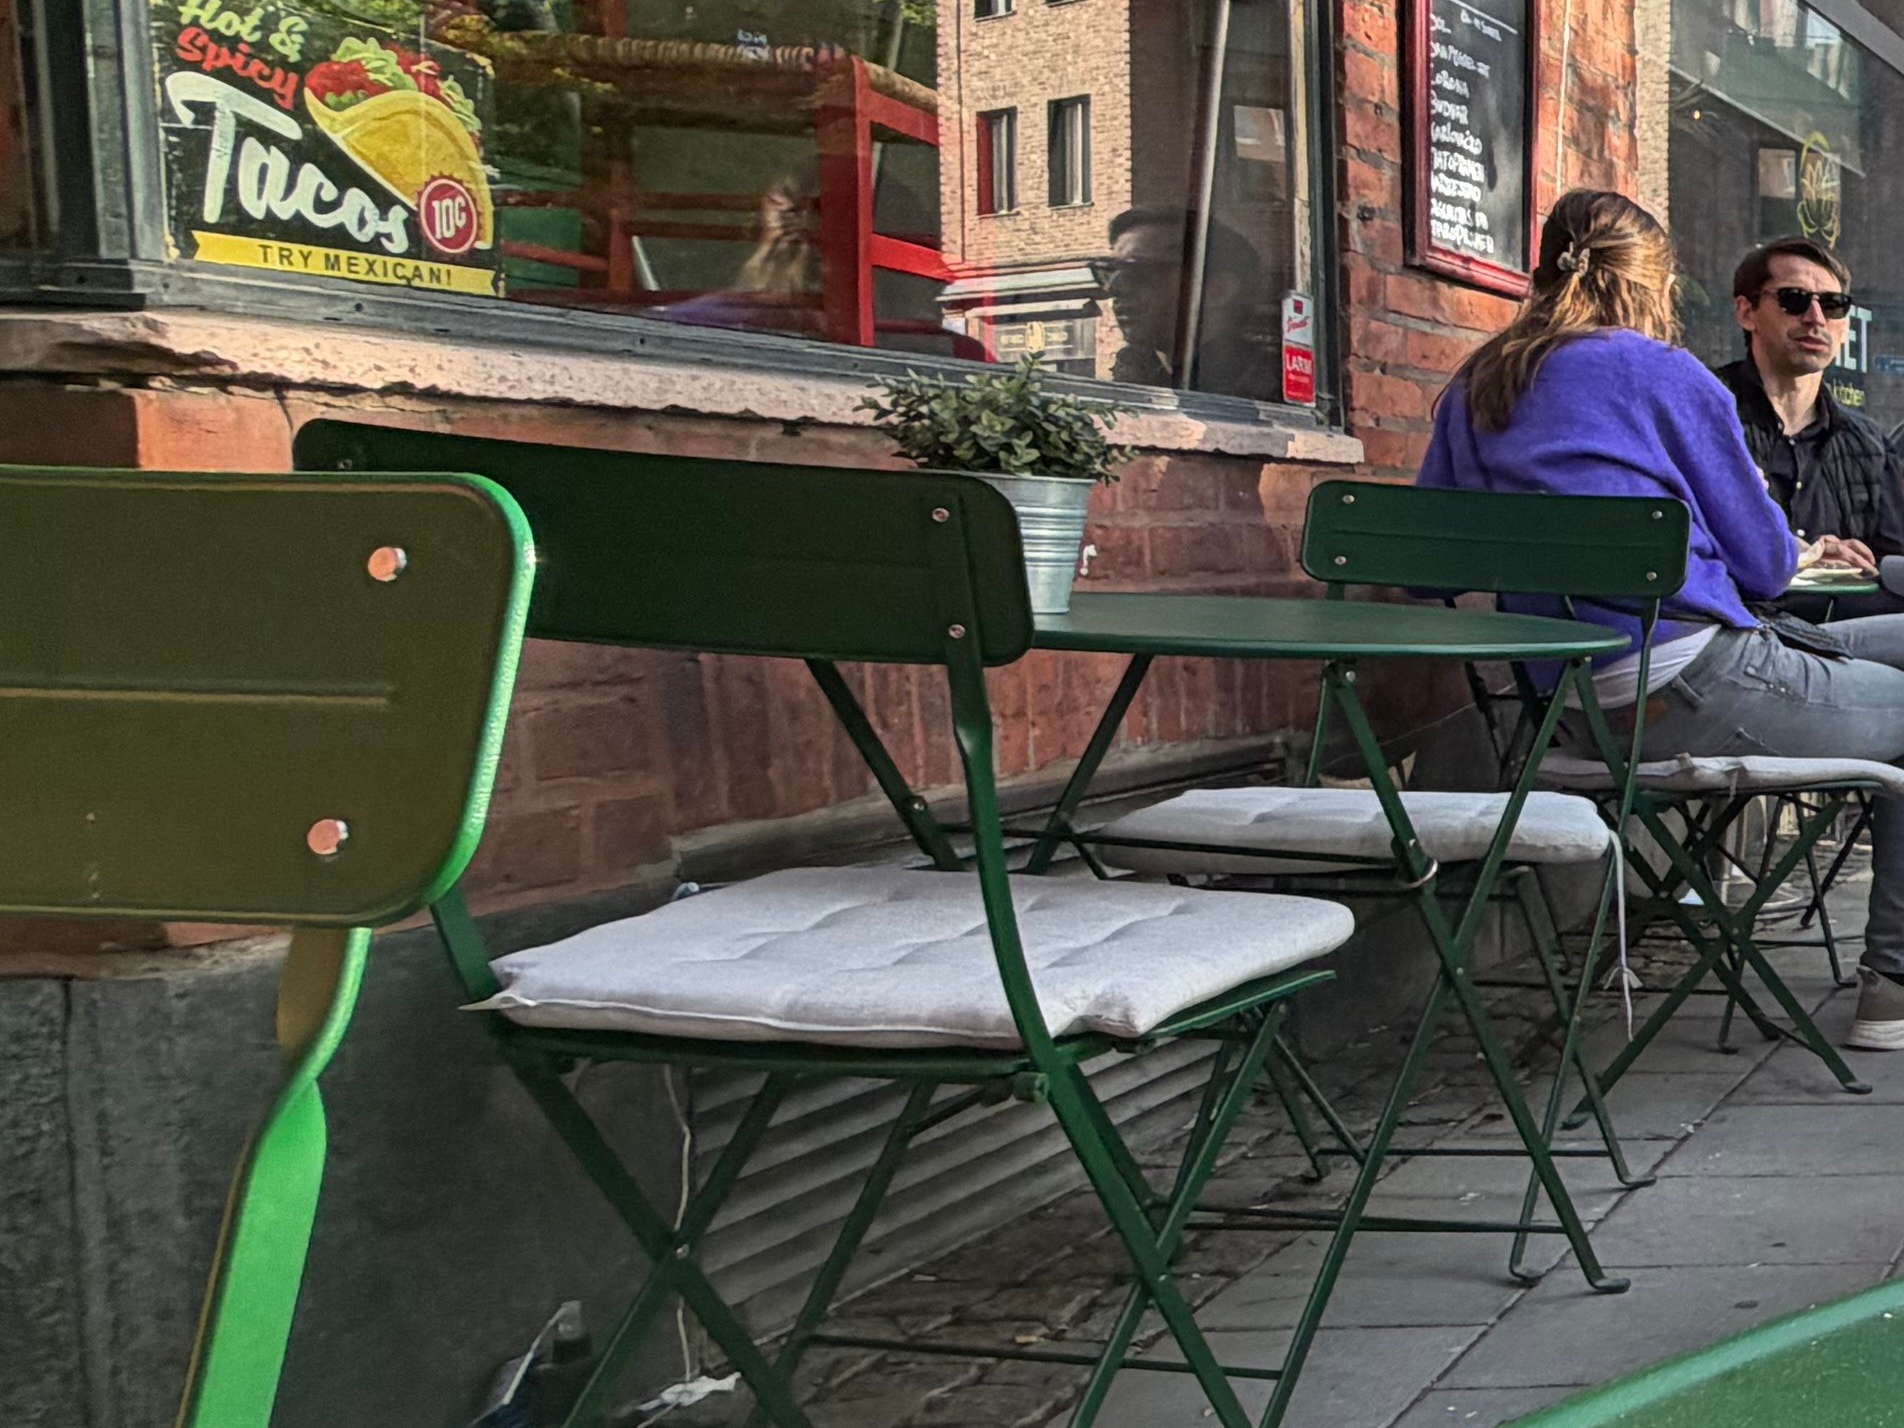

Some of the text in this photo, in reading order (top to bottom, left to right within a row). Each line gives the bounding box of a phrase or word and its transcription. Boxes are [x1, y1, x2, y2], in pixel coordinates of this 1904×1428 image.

[174, 26, 298, 111] Spicy
[268, 15, 309, 63] &
[165, 70, 410, 254] Tacos
[256, 243, 453, 287] TRY MEXICAN!
